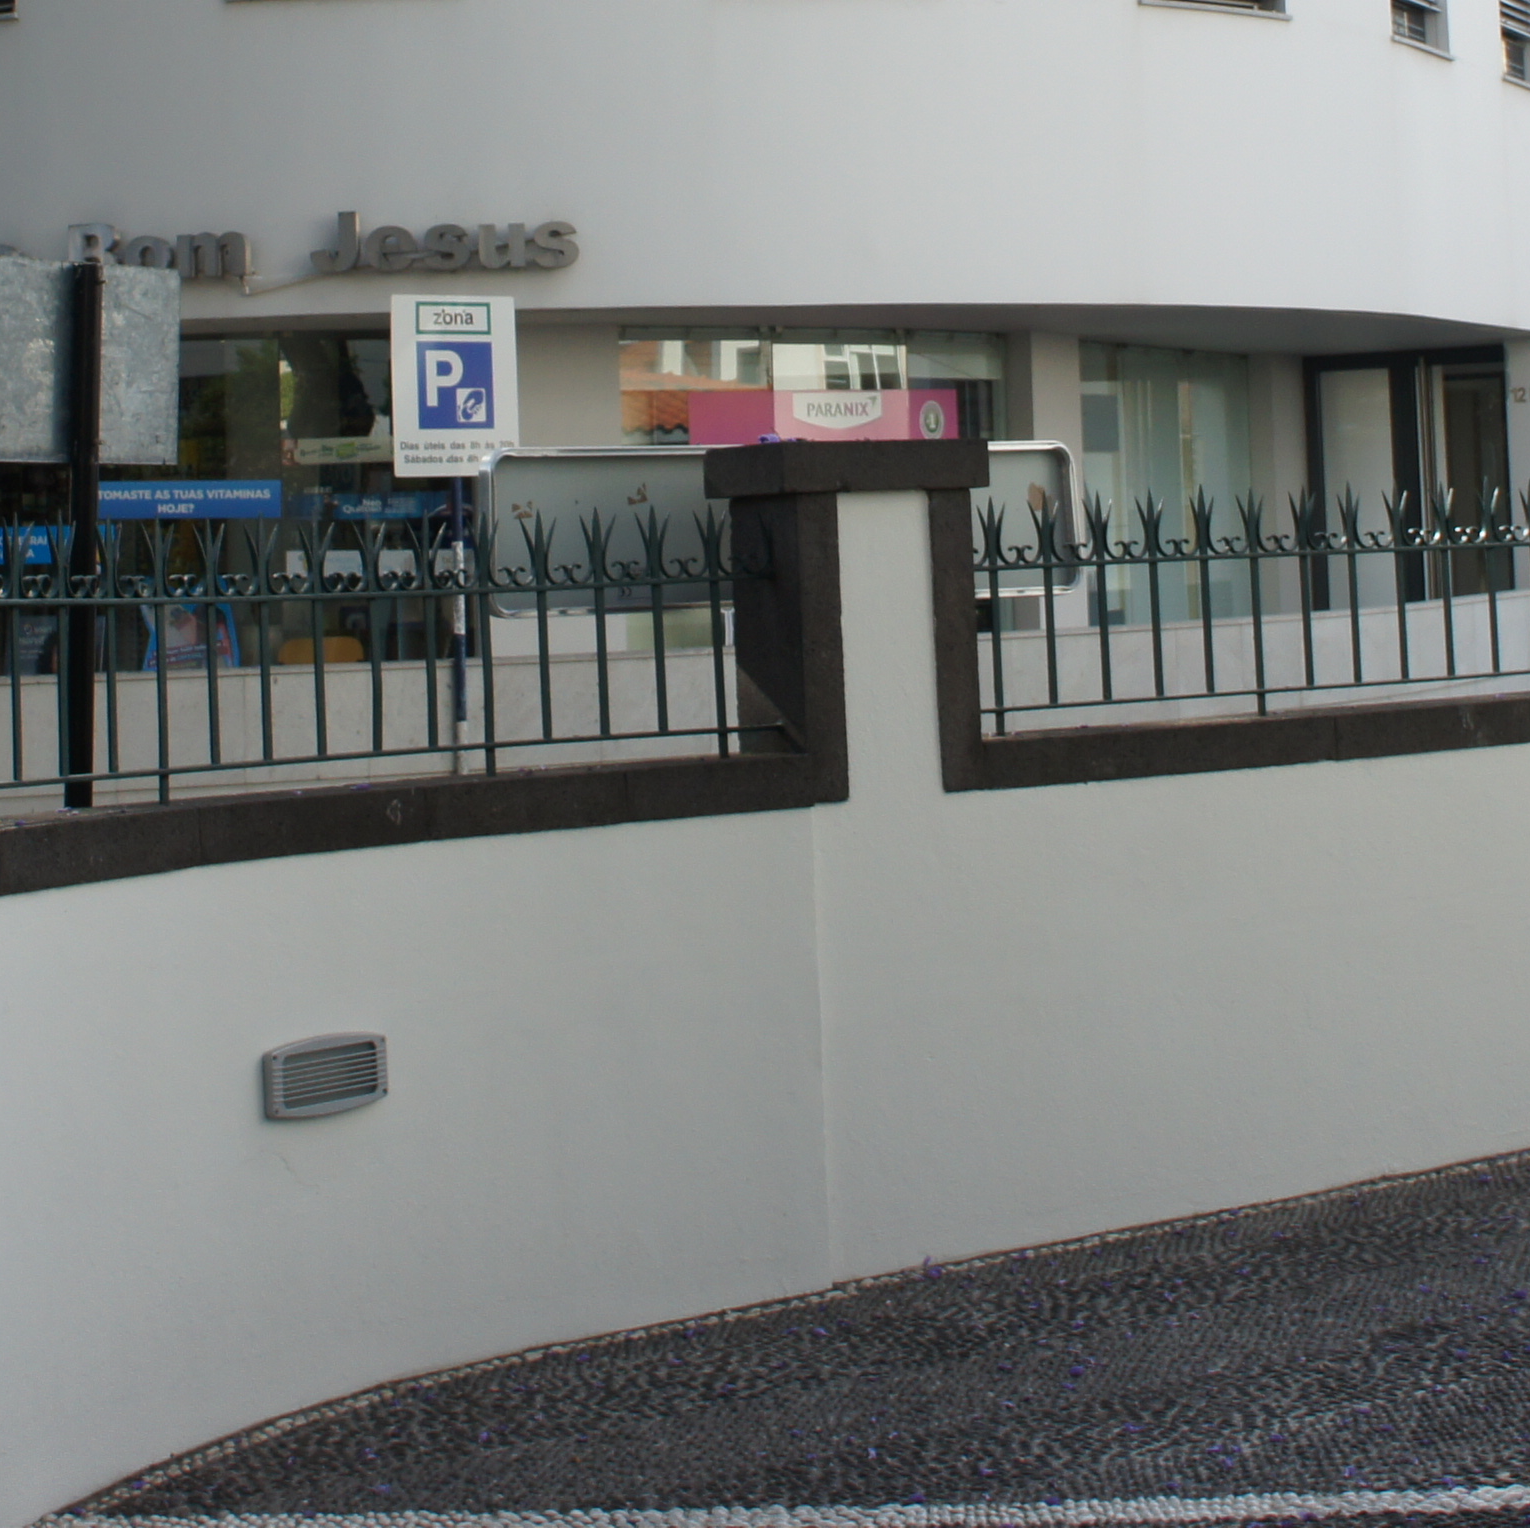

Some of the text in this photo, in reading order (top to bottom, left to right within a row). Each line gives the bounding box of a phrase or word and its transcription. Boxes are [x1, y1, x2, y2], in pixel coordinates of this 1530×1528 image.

[309, 211, 580, 273] Jesus
[433, 311, 474, 325] zona
[425, 349, 464, 407] P
[1509, 386, 1527, 403] 12
[806, 402, 869, 417] PARANIX
[400, 441, 419, 451] Dias
[424, 440, 446, 450] úteis
[450, 441, 466, 450] das
[404, 454, 444, 464] Sábados
[98, 488, 271, 500] TOMASTE AS TUAS VITAMINAS
[157, 503, 195, 514] HOJE?
